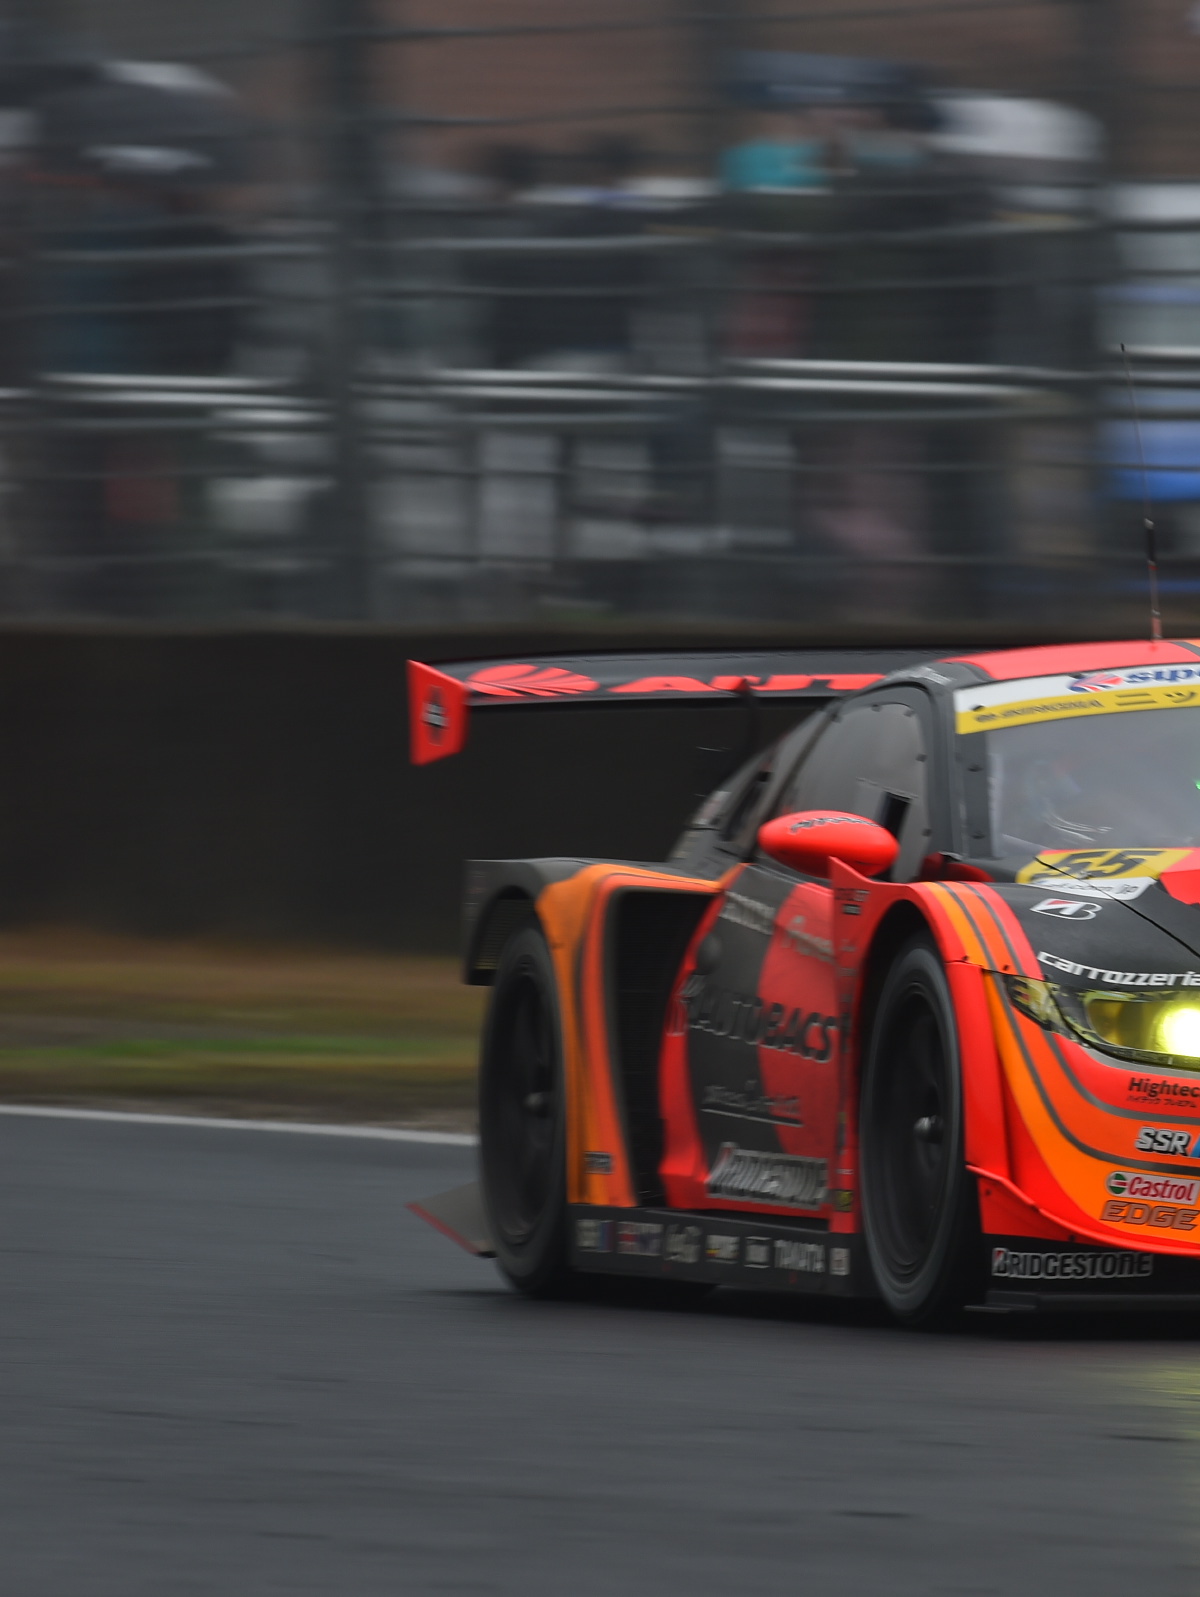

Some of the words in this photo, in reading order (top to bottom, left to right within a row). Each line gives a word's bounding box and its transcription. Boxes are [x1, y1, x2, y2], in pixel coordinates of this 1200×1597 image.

[608, 673, 884, 693] AUT
[1031, 850, 1167, 880] 55
[1134, 1126, 1192, 1157] SSR
[1127, 1174, 1196, 1202] Castrol
[992, 1247, 1154, 1279] BRIDGESTONE
